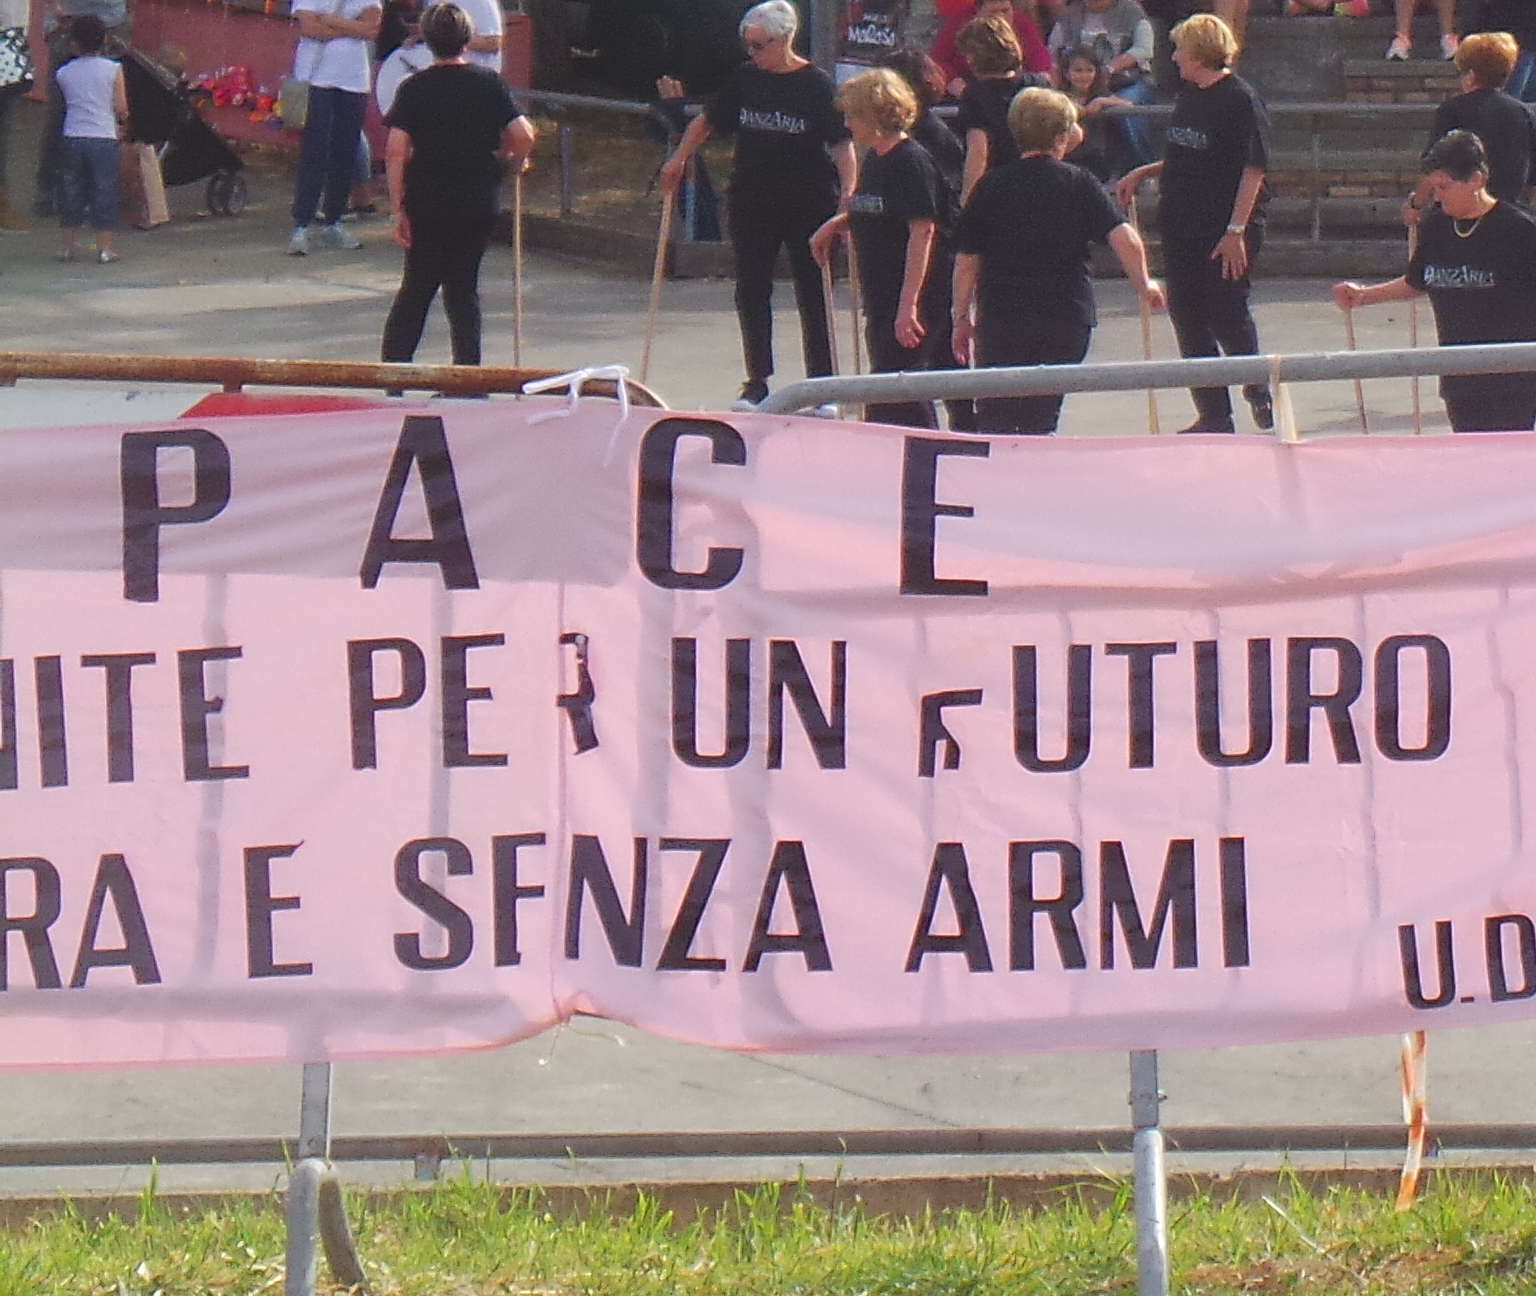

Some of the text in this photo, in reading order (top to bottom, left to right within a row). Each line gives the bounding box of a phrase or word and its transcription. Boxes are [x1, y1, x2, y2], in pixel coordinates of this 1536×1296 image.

[121, 414, 991, 603] PACE
[0, 646, 250, 790] ITE
[346, 631, 599, 771] PER
[671, 636, 848, 771] UN
[244, 839, 313, 980] E
[904, 835, 1252, 974] ARMI
